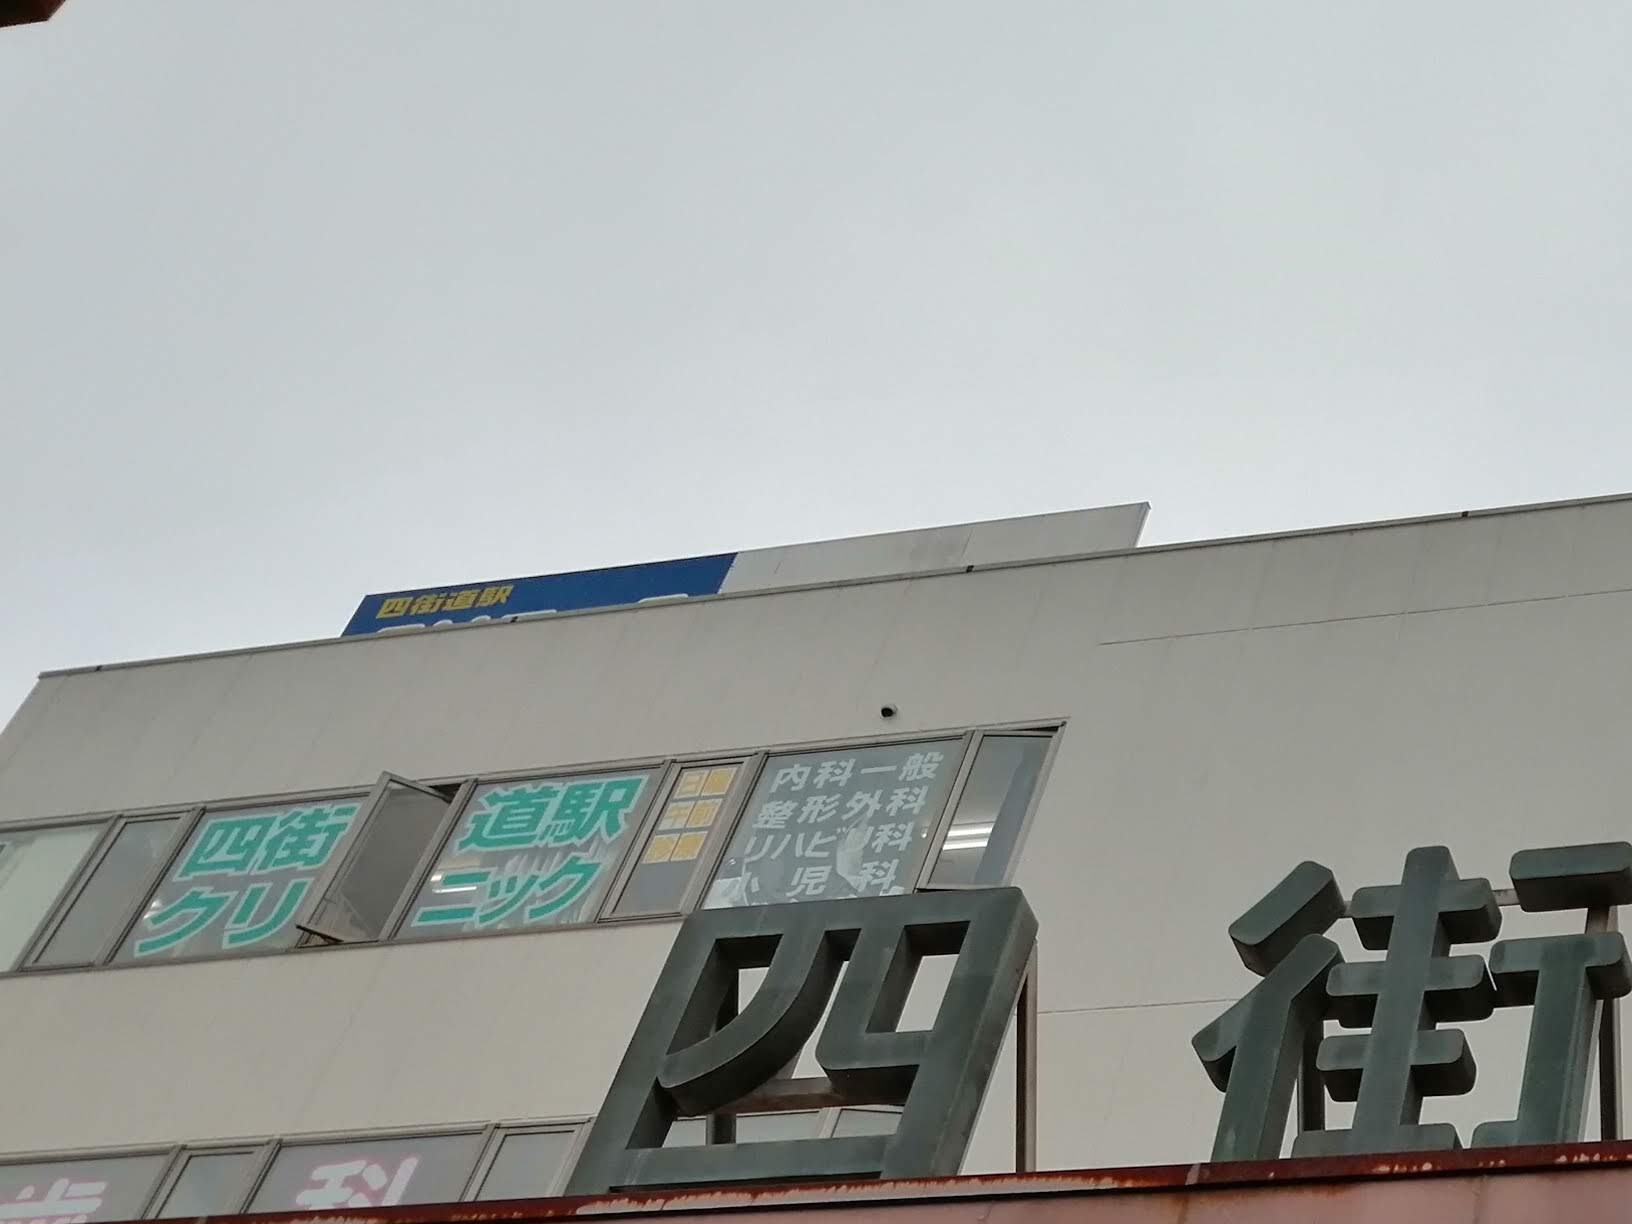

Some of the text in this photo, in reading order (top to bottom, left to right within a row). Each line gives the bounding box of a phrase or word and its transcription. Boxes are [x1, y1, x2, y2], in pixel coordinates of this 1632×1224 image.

[375, 584, 515, 620] 四街道駅
[751, 785, 929, 830] 整形外科
